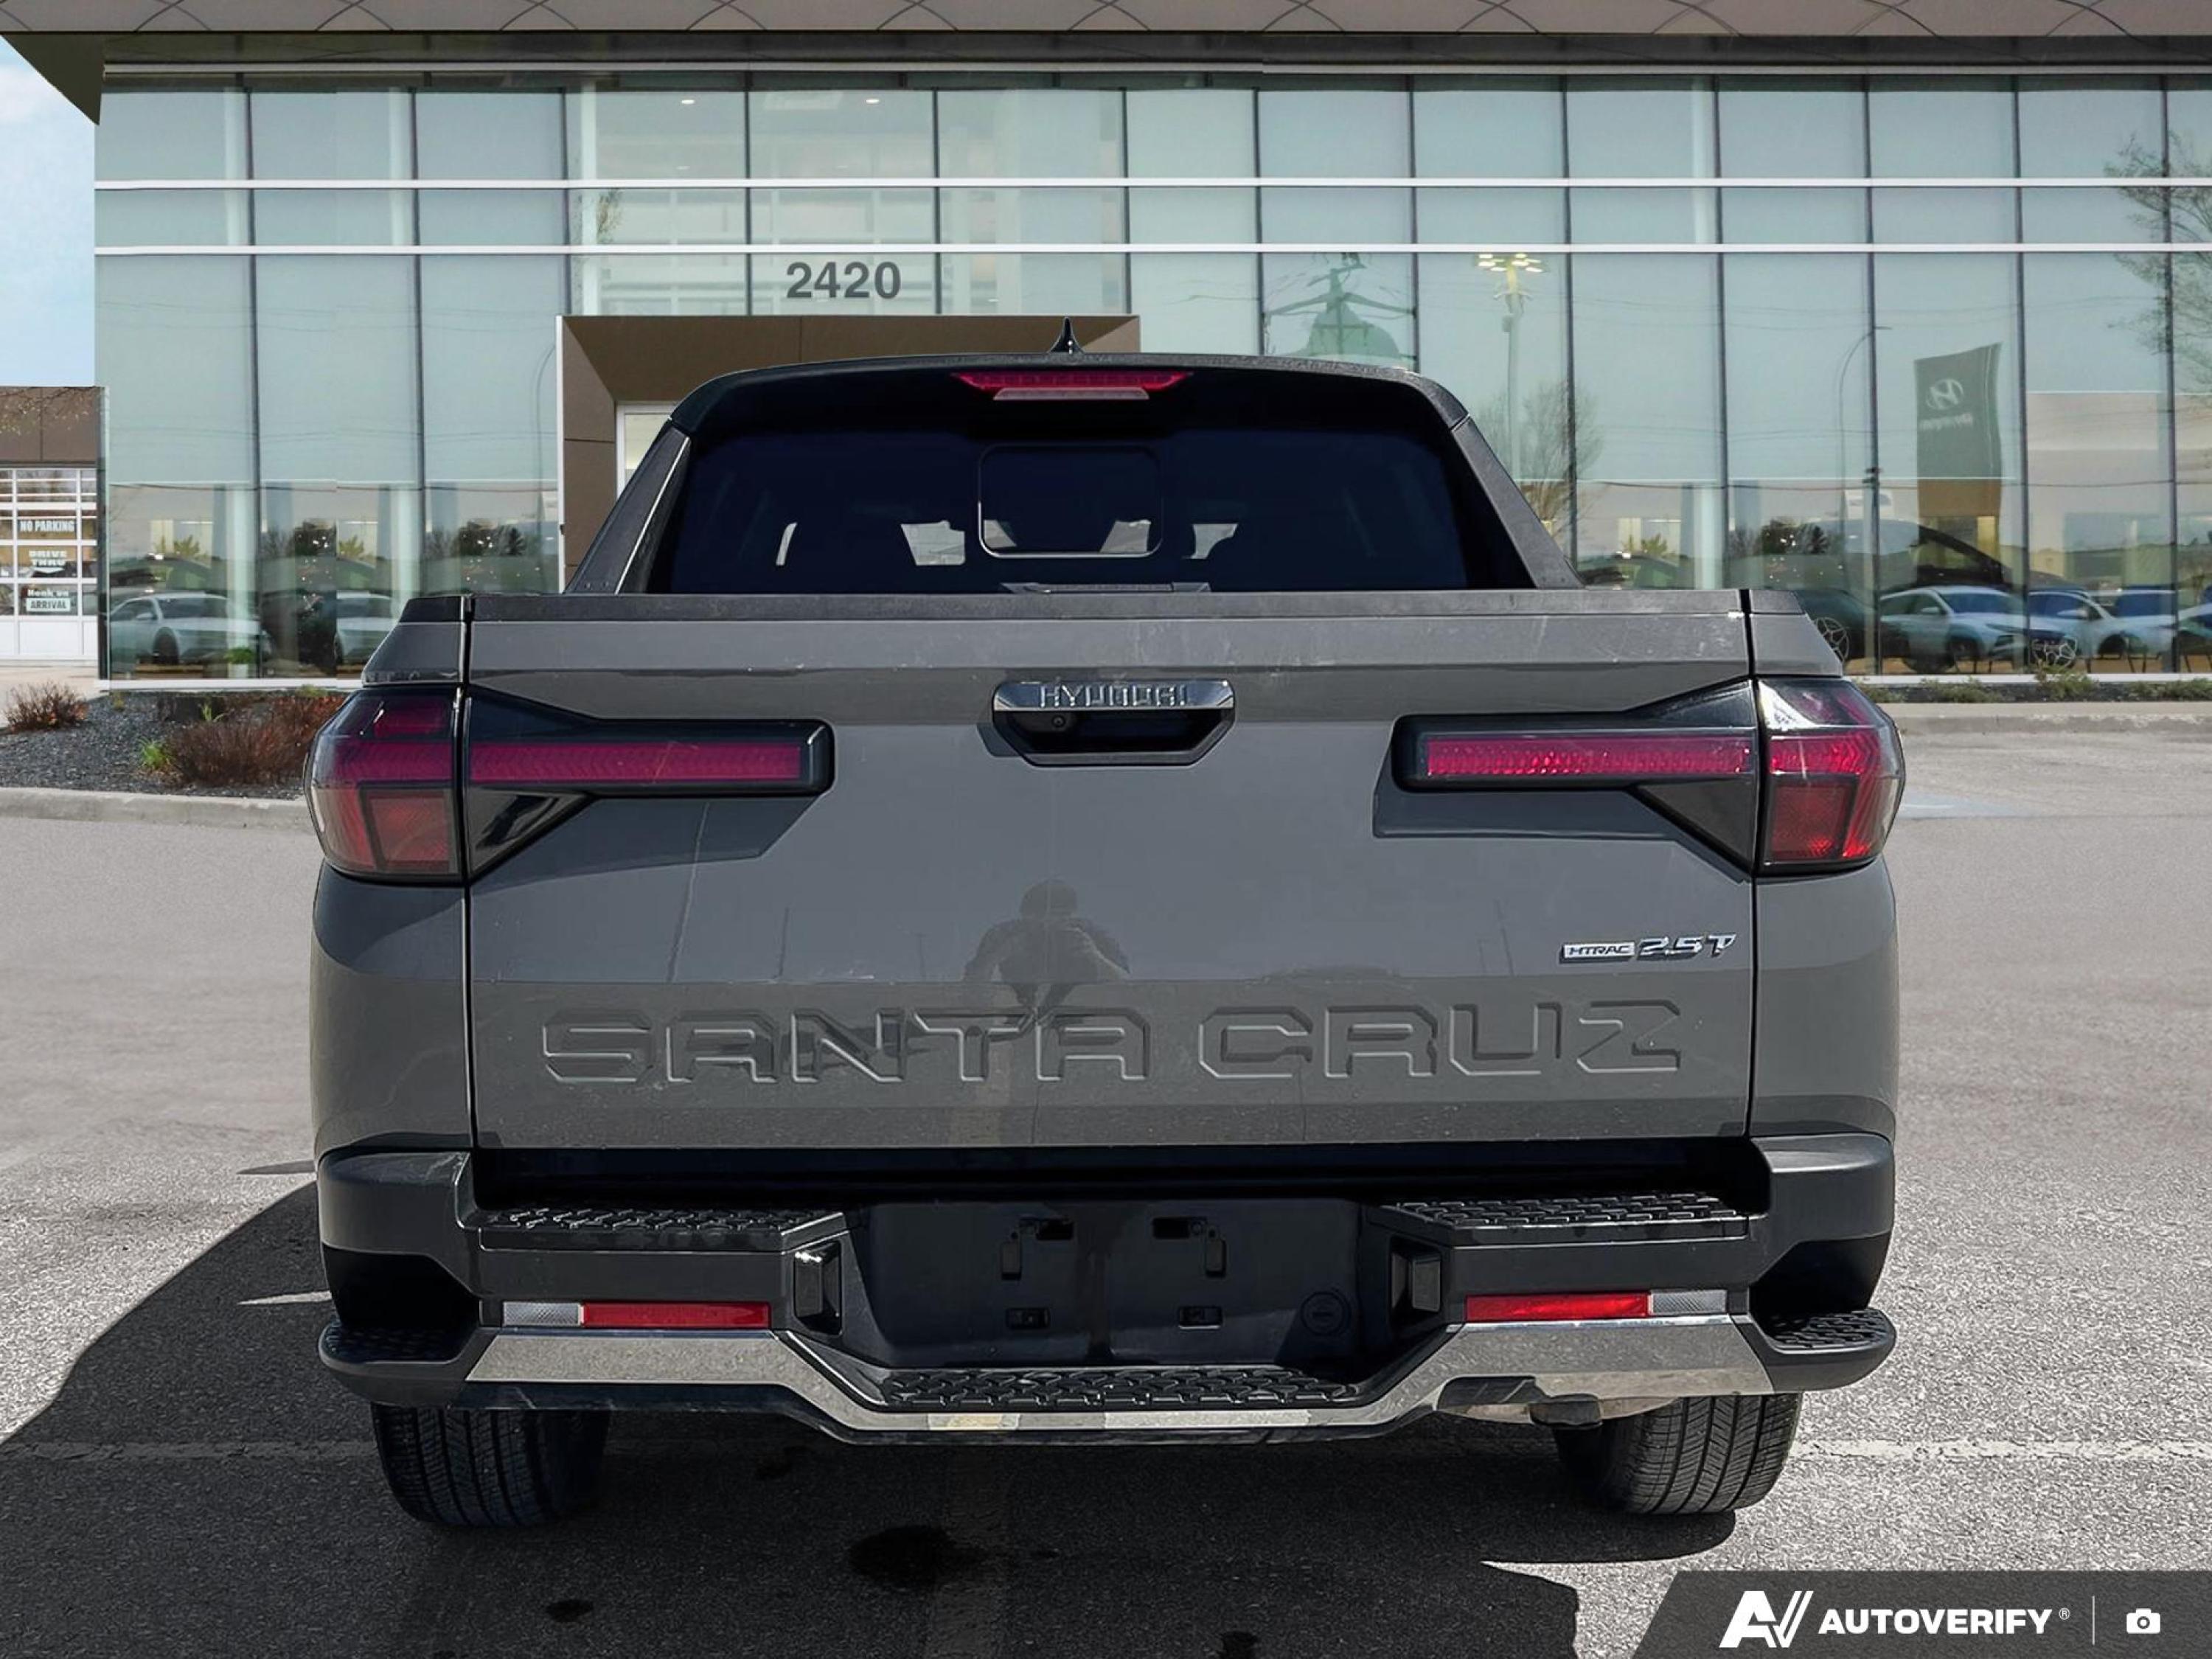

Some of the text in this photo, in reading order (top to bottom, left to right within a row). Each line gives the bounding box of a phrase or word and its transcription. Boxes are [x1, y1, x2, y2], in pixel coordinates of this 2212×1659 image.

[786, 261, 901, 299] 2420
[20, 520, 74, 532] NO PARKING
[29, 599, 68, 609] ARRIVAL
[1040, 683, 1189, 708] HYUNDAI
[1639, 933, 1737, 958] 2.5T
[542, 1000, 1682, 1083] SANTA CRUZ
